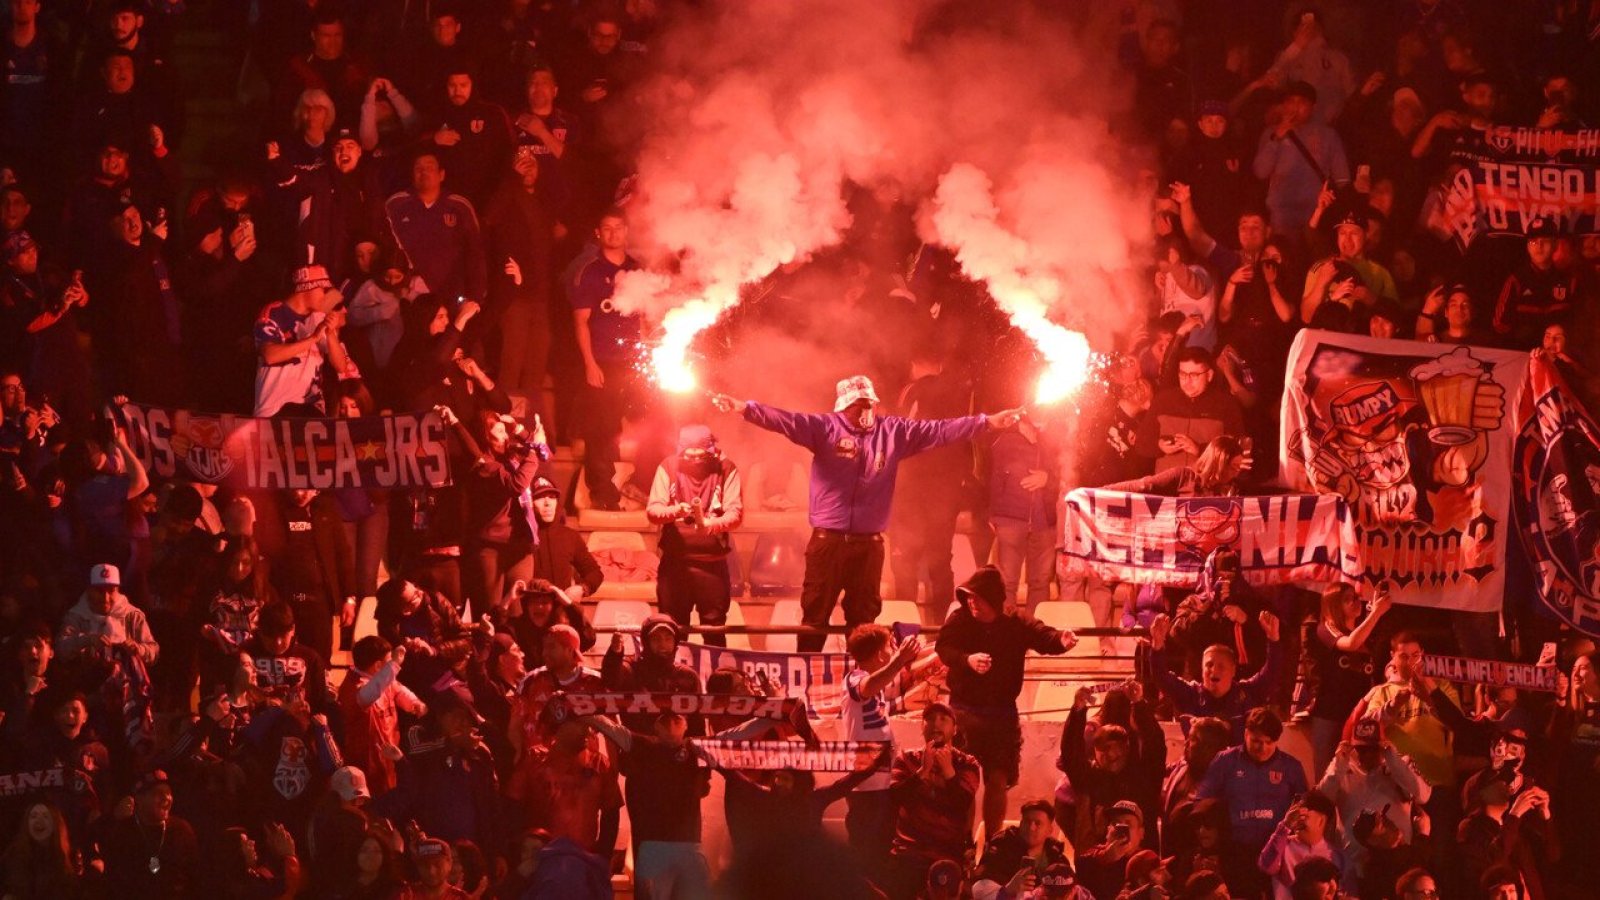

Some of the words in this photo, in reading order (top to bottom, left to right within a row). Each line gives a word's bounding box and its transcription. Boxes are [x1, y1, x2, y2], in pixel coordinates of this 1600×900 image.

[374, 413, 450, 488] JRS
[1424, 655, 1463, 679] MALA
[1466, 660, 1546, 688] INFLUENCIA
